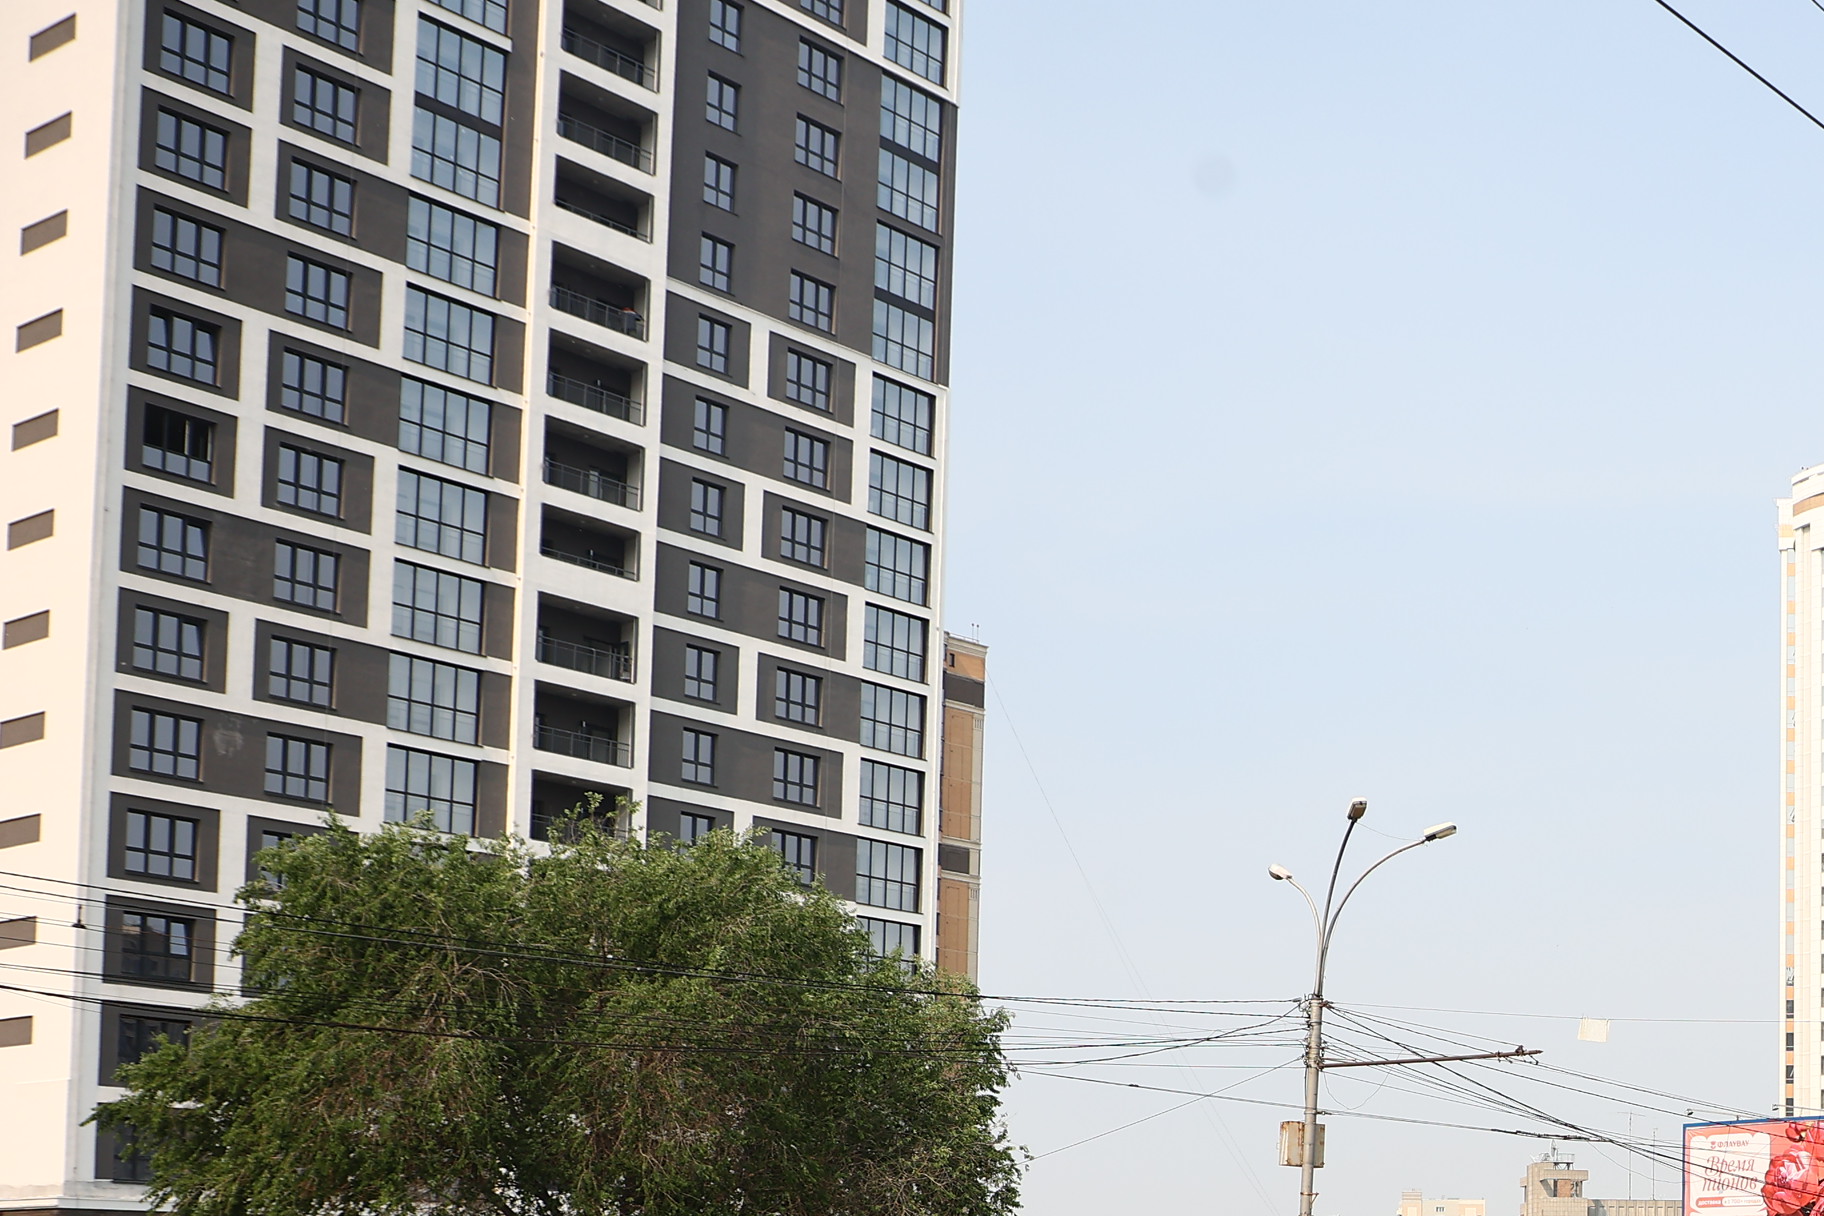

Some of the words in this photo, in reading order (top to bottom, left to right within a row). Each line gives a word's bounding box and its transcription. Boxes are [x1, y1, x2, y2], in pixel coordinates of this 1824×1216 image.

[1717, 1140, 1750, 1149] ФЛАУВАУ
[1705, 1156, 1755, 1177] Время
[1702, 1176, 1758, 1192] пионов
